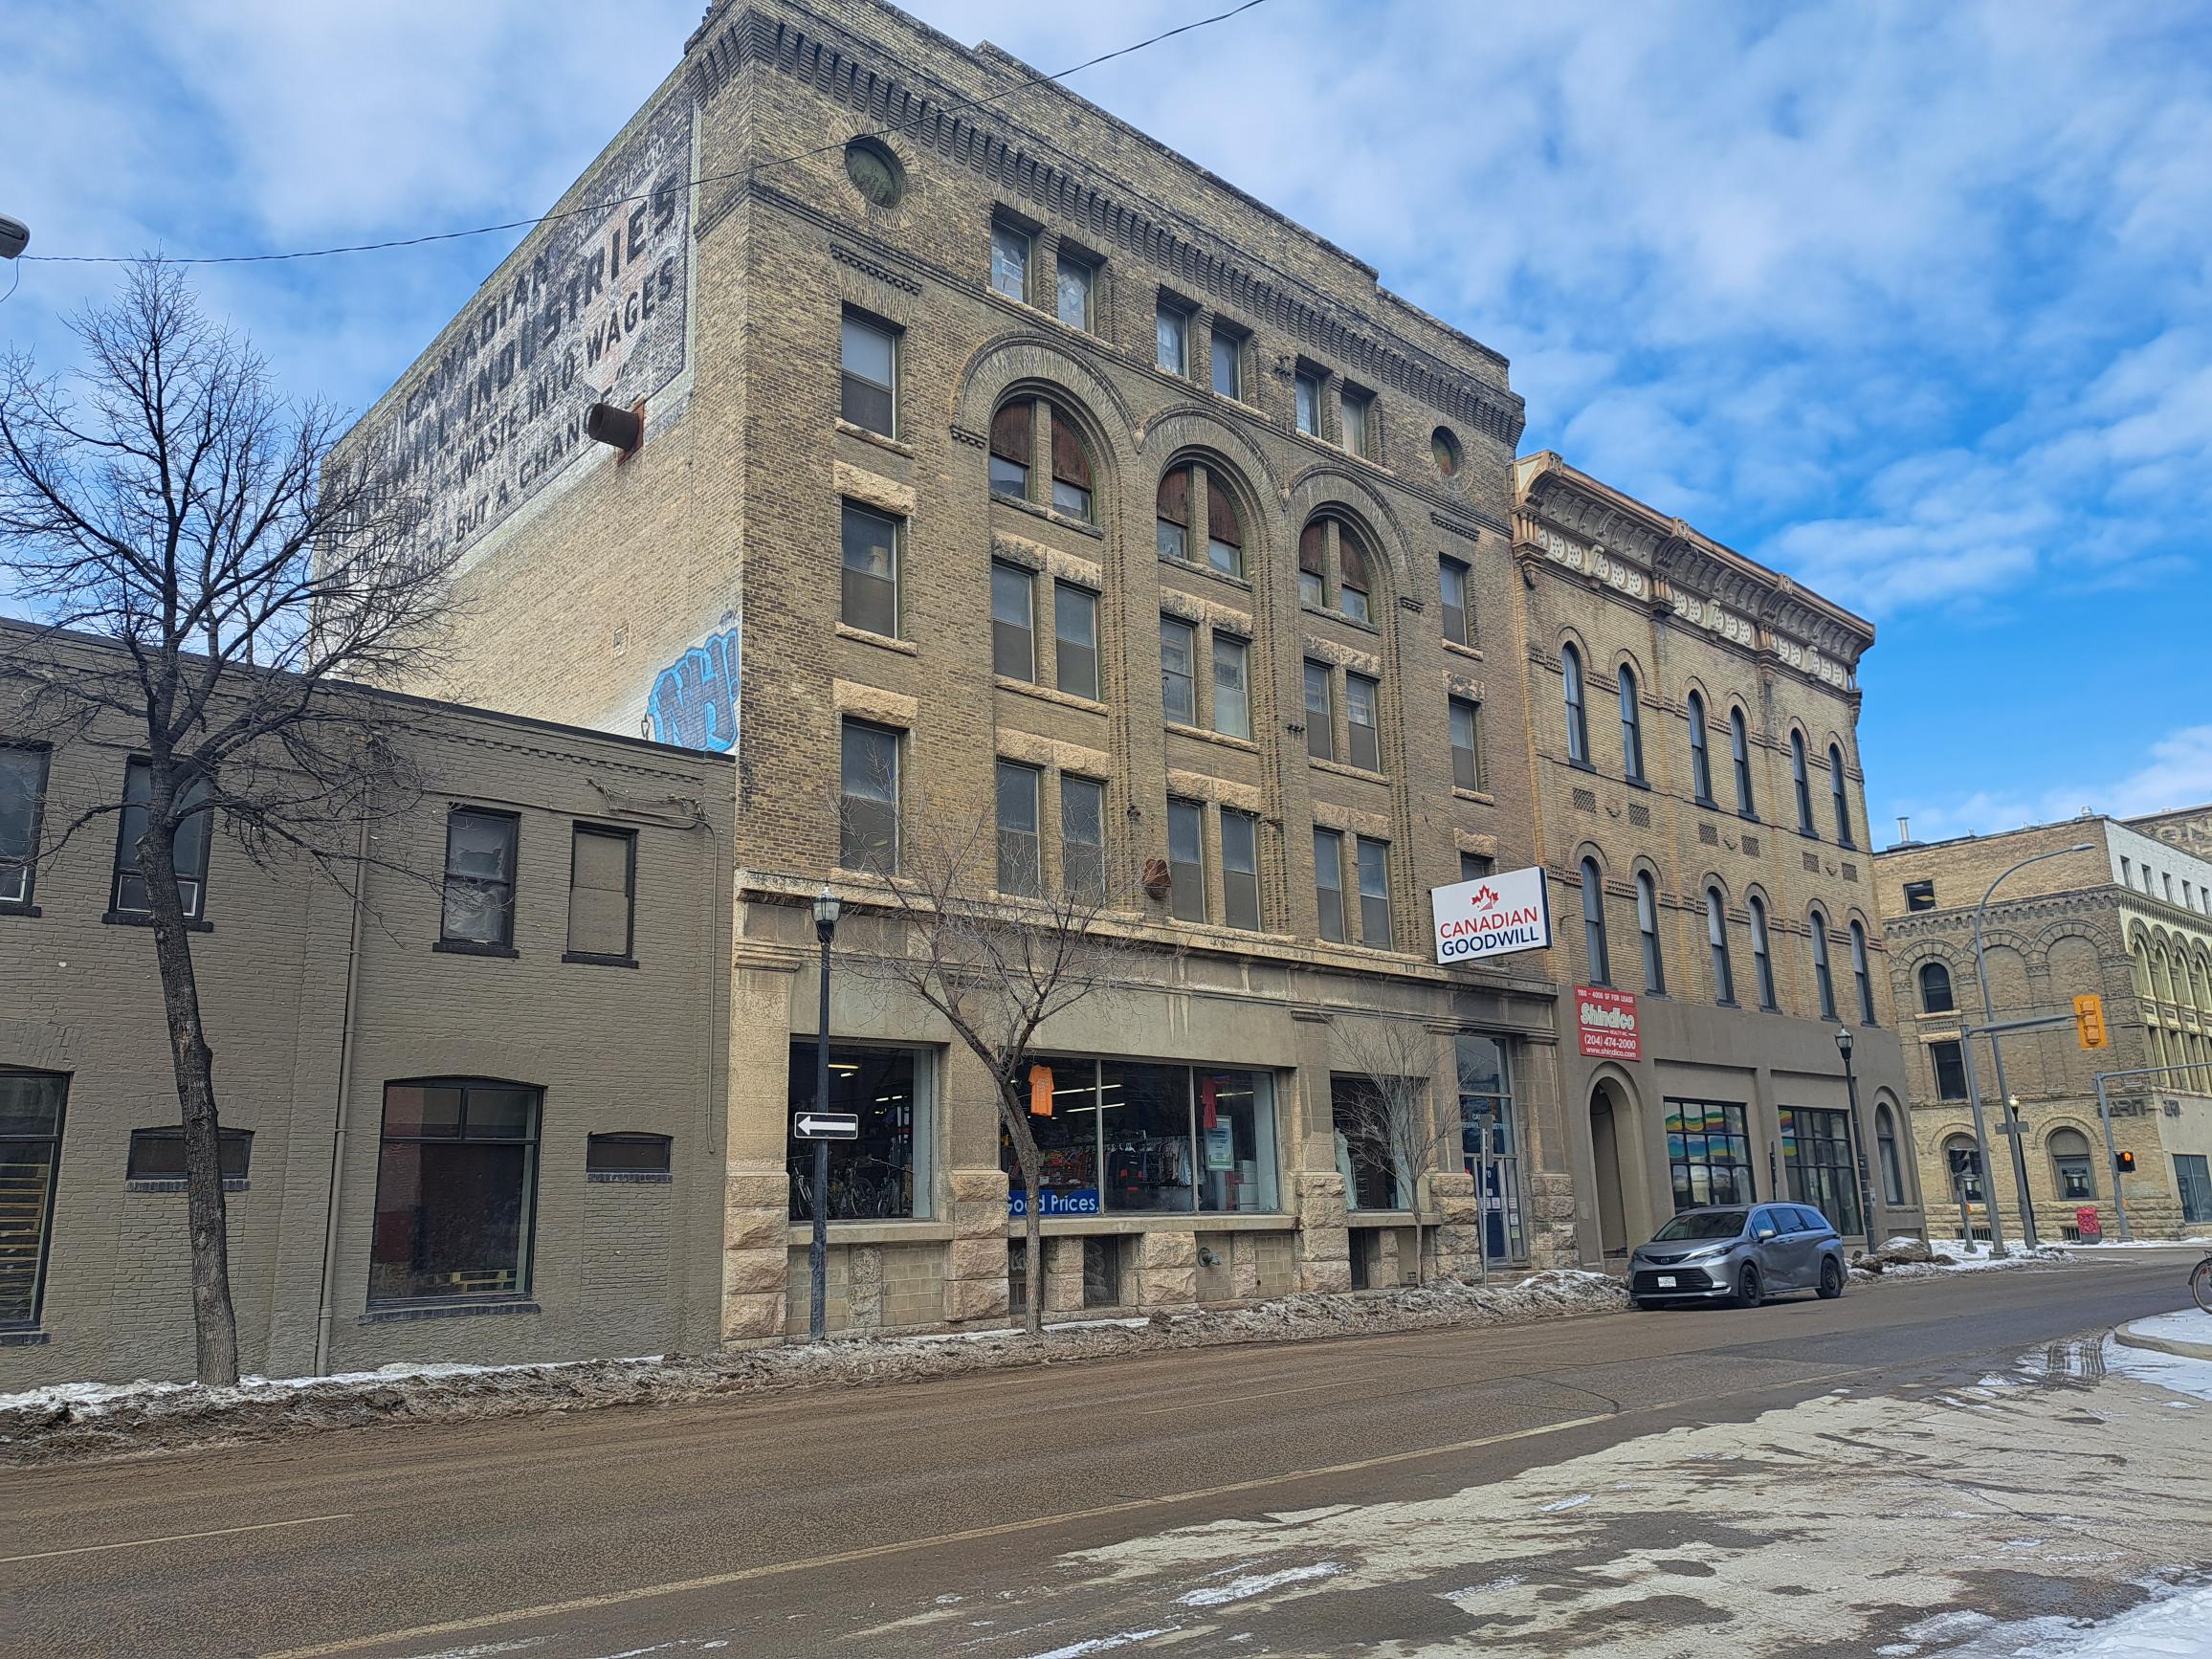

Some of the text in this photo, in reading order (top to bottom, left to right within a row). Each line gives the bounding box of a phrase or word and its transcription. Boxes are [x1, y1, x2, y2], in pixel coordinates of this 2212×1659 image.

[464, 171, 676, 426] INDUSTRIES
[459, 402, 520, 487] WASTE
[527, 346, 575, 424] INTO
[585, 256, 675, 369] WAGES
[455, 494, 489, 544] BUT
[497, 477, 509, 514] A
[1440, 906, 1538, 939] CANADIAN
[1442, 926, 1539, 956] GOODWILL
[1581, 1002, 1634, 1030] Shindico
[1584, 1033, 1636, 1050] (204) 474-2000
[1586, 1047, 1636, 1058] www.shindico.com
